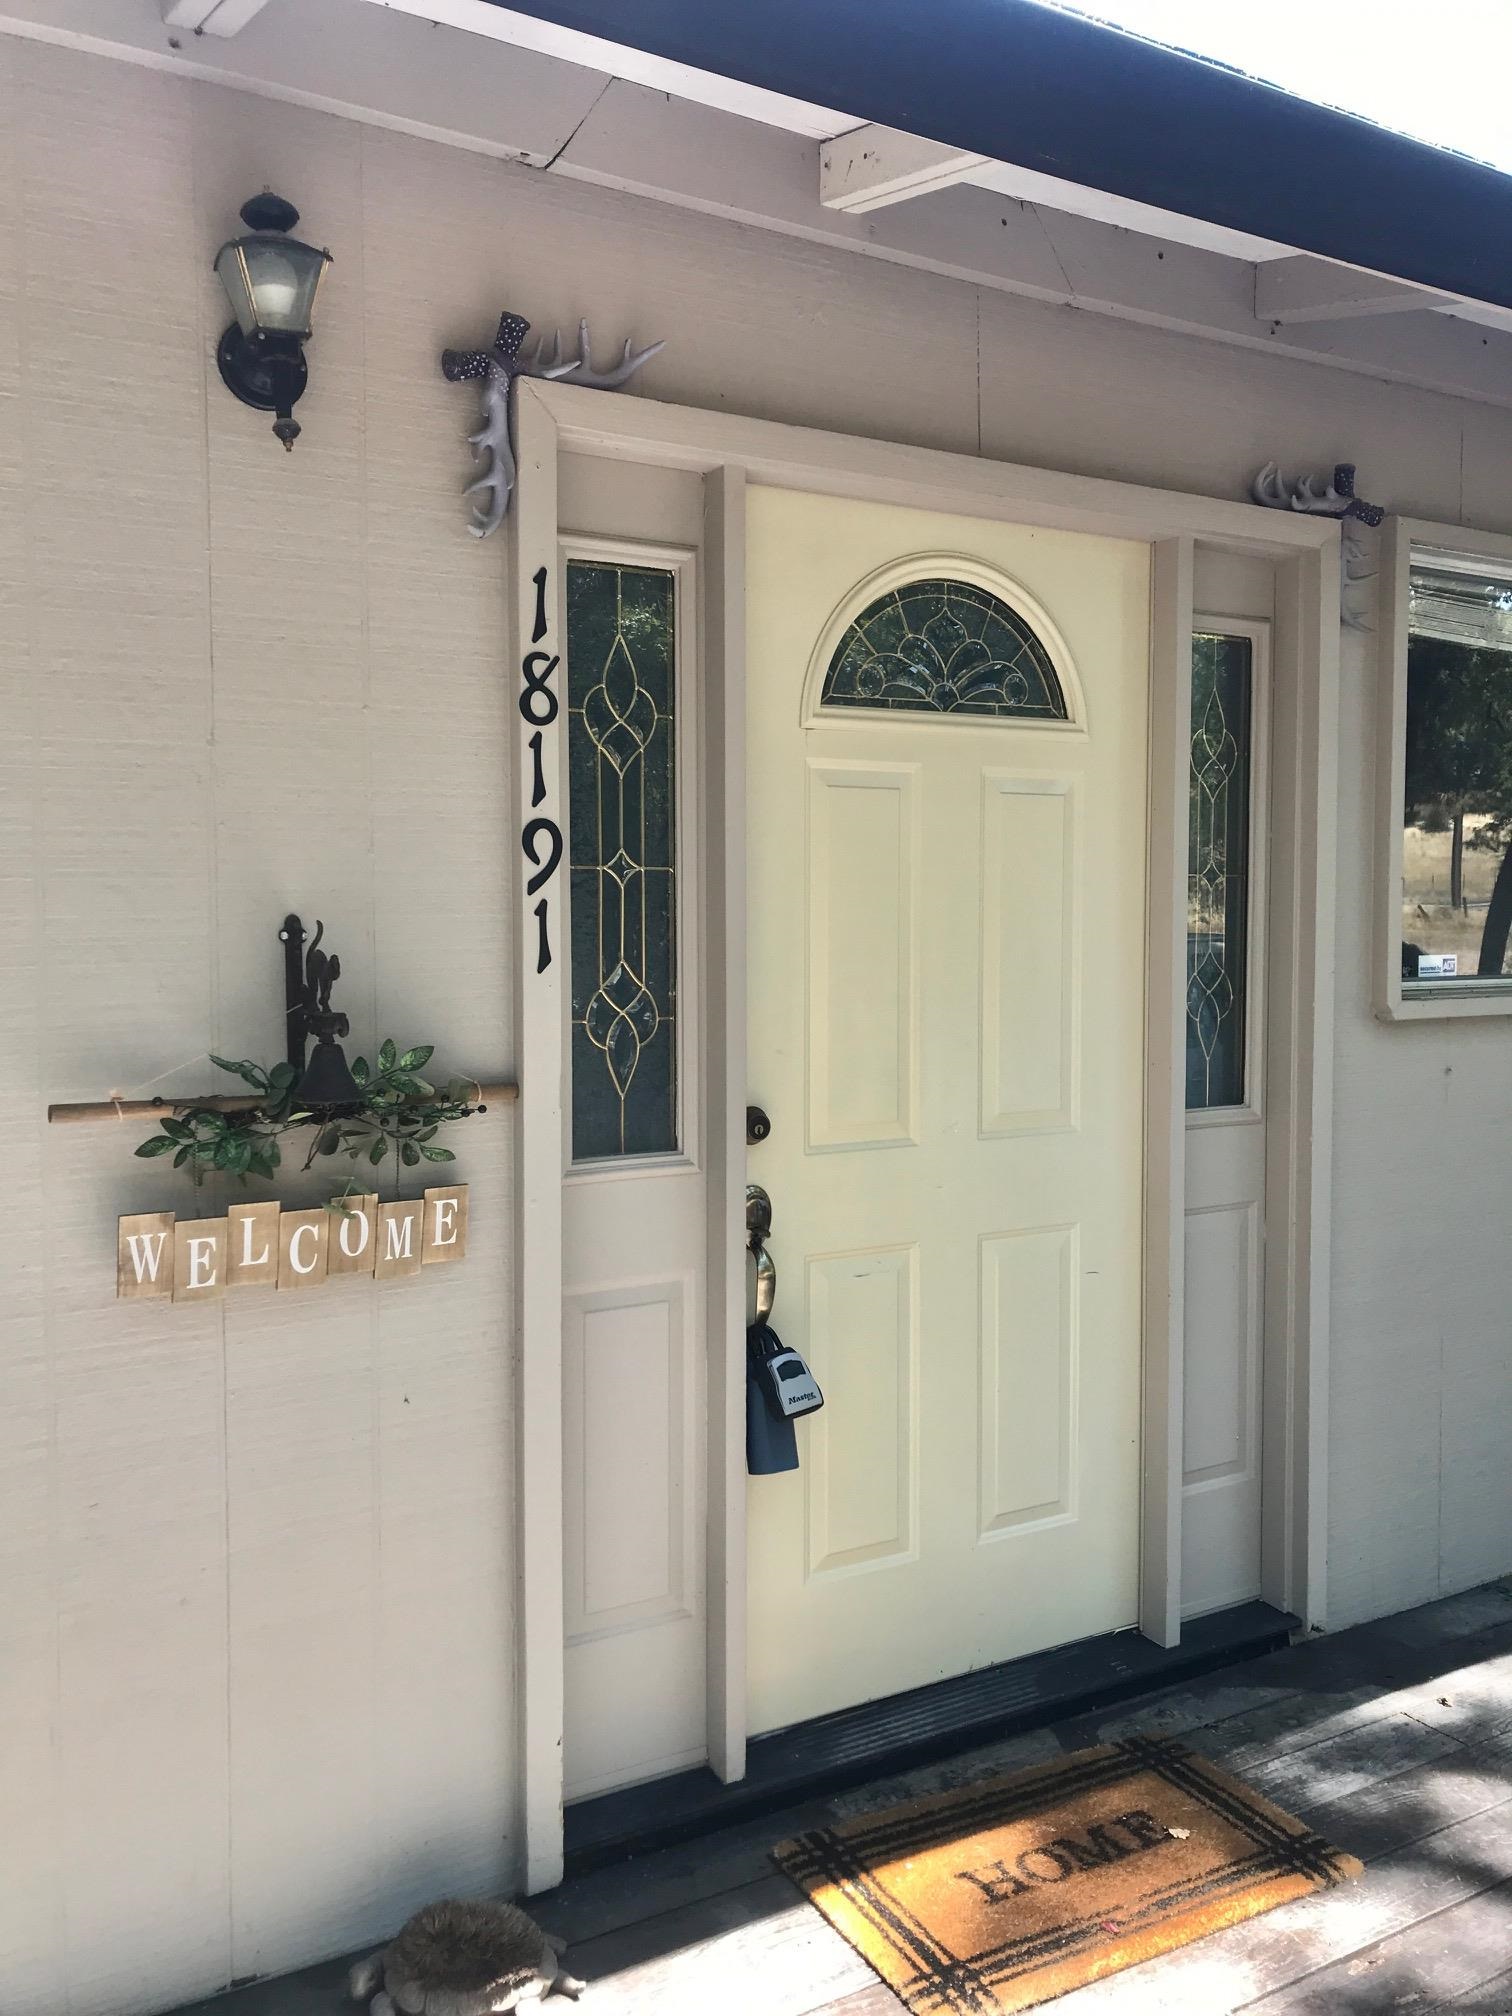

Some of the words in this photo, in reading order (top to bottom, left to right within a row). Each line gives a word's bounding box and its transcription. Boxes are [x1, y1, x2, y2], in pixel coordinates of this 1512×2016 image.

[519, 567, 563, 974] 18191
[126, 1198, 459, 1289] WELCOME
[788, 1392, 815, 1405] Master
[955, 1810, 1173, 1905] HOME
